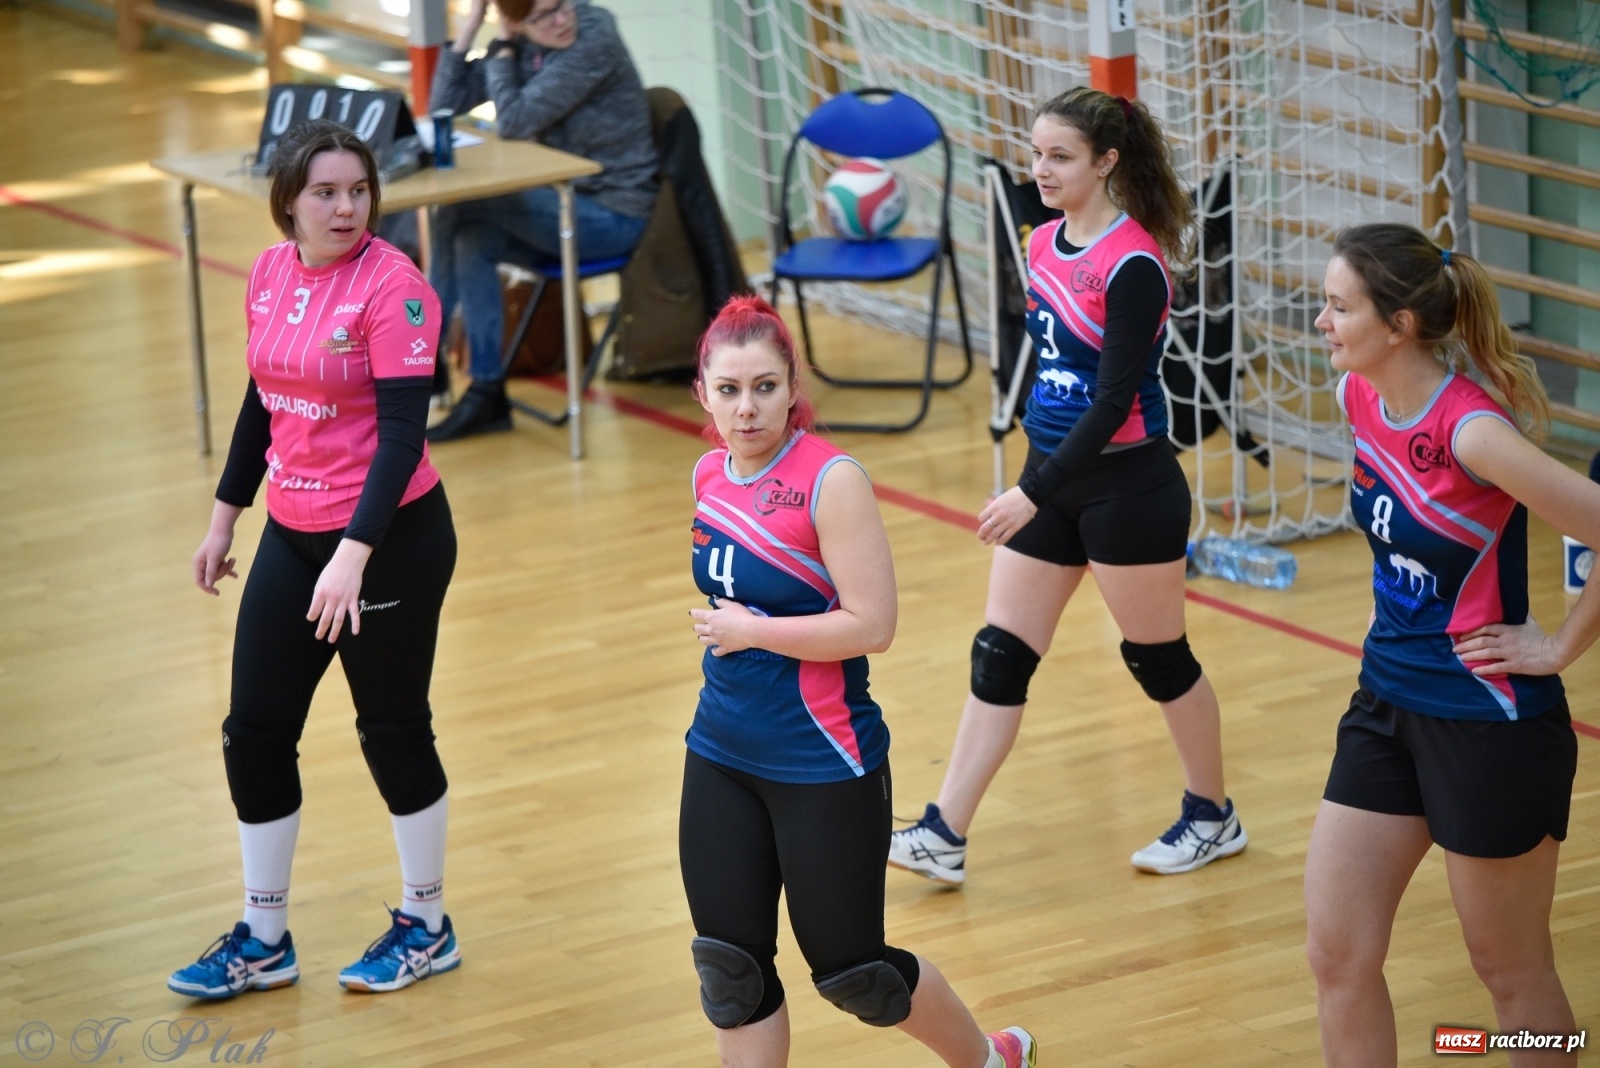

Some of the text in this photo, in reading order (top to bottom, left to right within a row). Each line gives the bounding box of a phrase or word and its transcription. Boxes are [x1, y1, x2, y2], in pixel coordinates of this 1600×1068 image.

[287, 287, 311, 325] 3
[1037, 310, 1060, 360] 3
[402, 356, 434, 366] TAURON
[268, 393, 337, 420] TAURON
[1371, 494, 1394, 544] 8
[708, 544, 735, 598] 4
